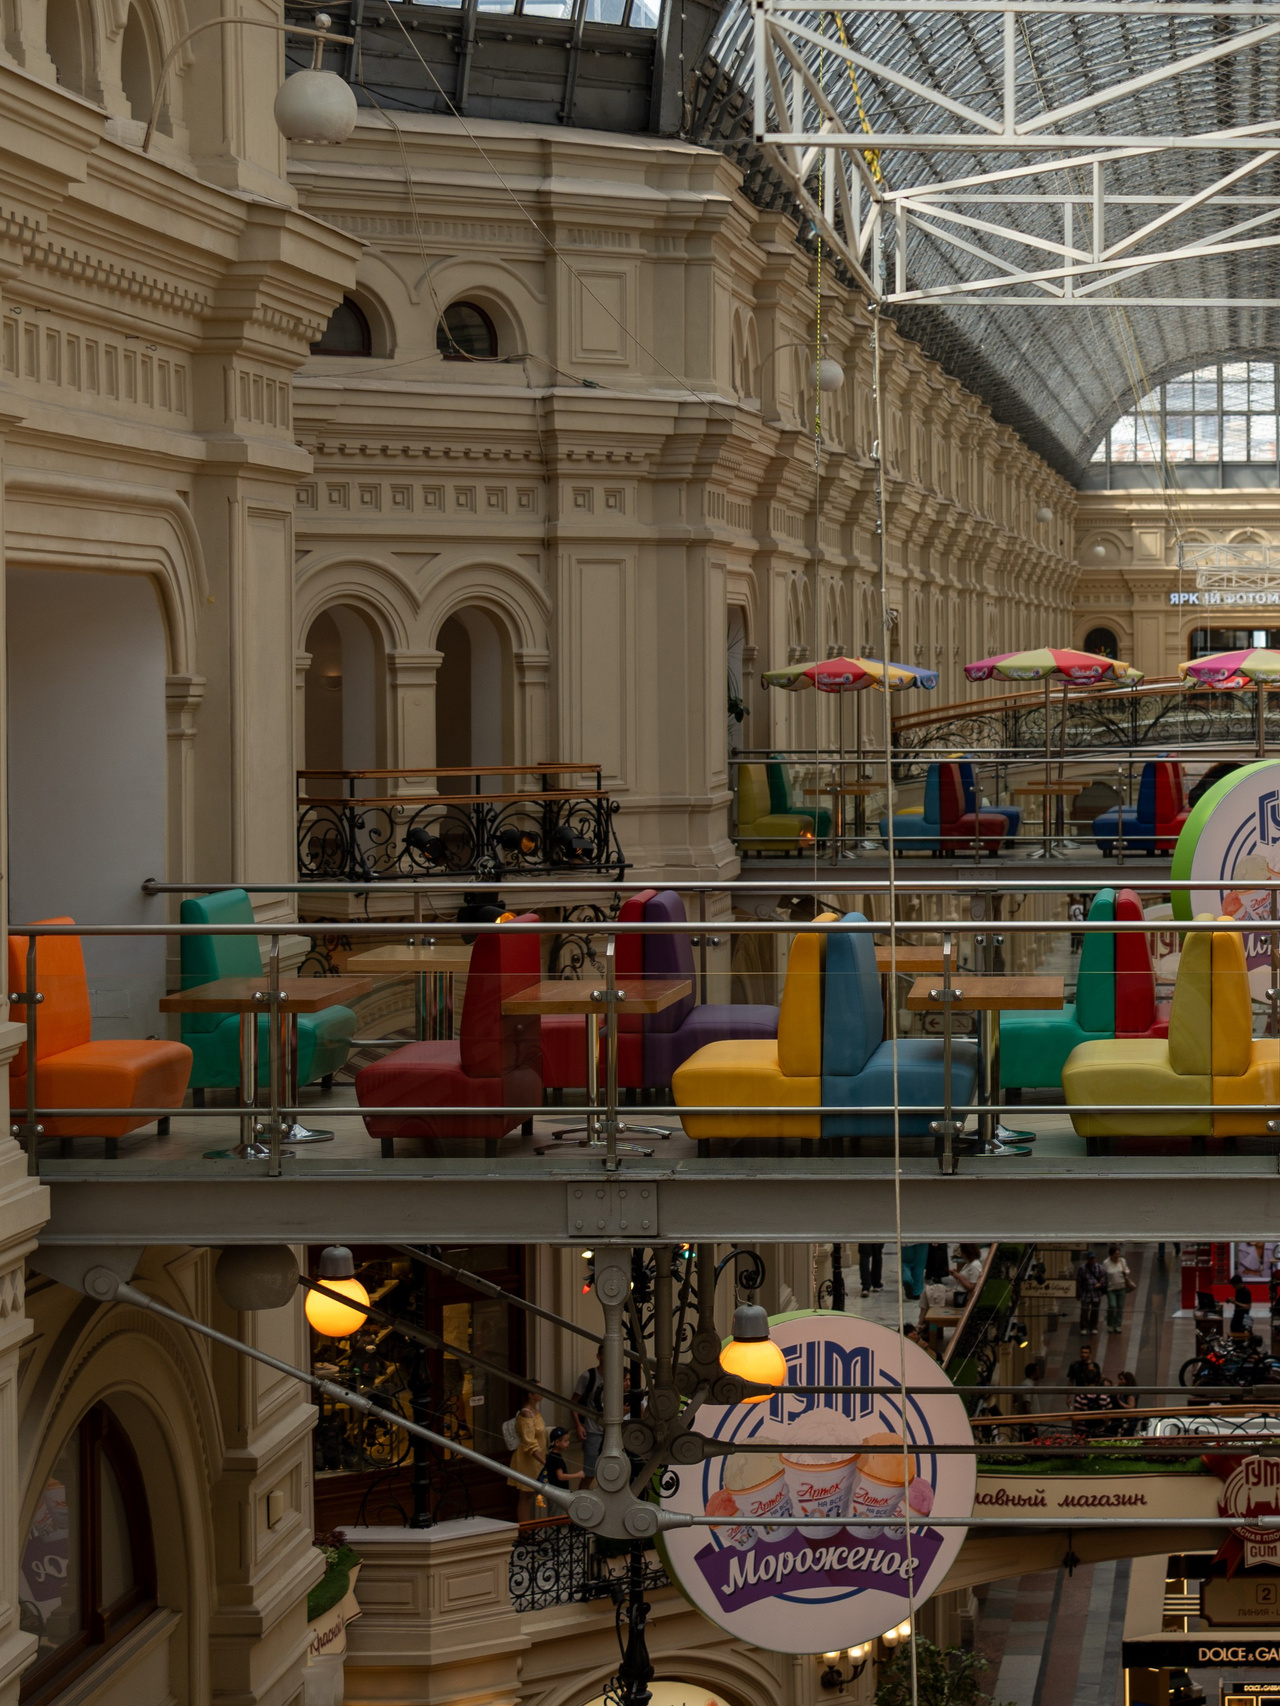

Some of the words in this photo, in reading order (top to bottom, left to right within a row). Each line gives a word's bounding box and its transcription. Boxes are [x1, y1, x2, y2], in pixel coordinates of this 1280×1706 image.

[1245, 1460, 1280, 1487] ГУМ
[1057, 1493, 1147, 1507] магазин
[1250, 1545, 1278, 1558] GUM
[720, 1547, 920, 1596] Мороженое
[1262, 1587, 1271, 1601] 2
